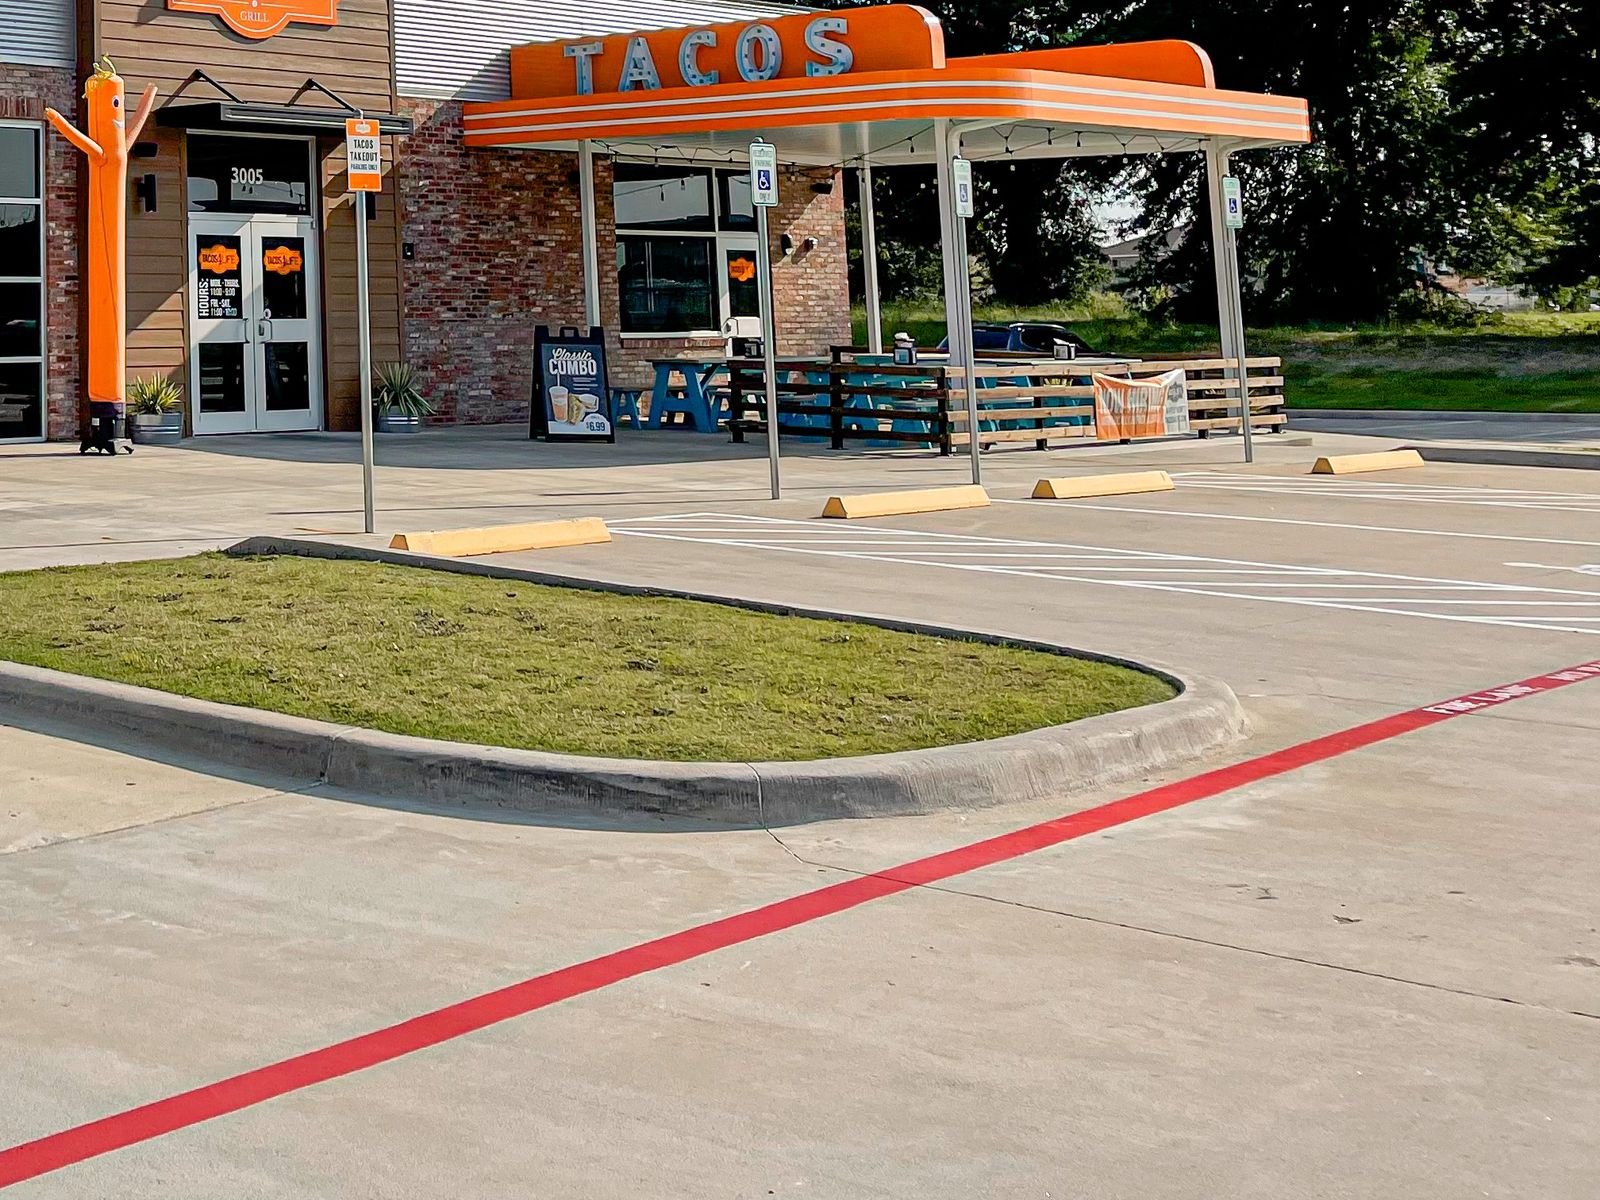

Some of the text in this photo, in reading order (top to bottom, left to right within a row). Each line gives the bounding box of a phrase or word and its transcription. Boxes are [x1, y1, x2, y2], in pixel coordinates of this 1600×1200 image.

[239, 11, 269, 23] GRILL
[563, 17, 854, 95] TACOS
[354, 140, 373, 149] TACOS
[350, 152, 377, 162] TAKEOUT
[231, 167, 263, 185] 3005
[552, 348, 592, 361] Classic
[549, 359, 597, 375] COMBO
[586, 422, 605, 431] $6.99
